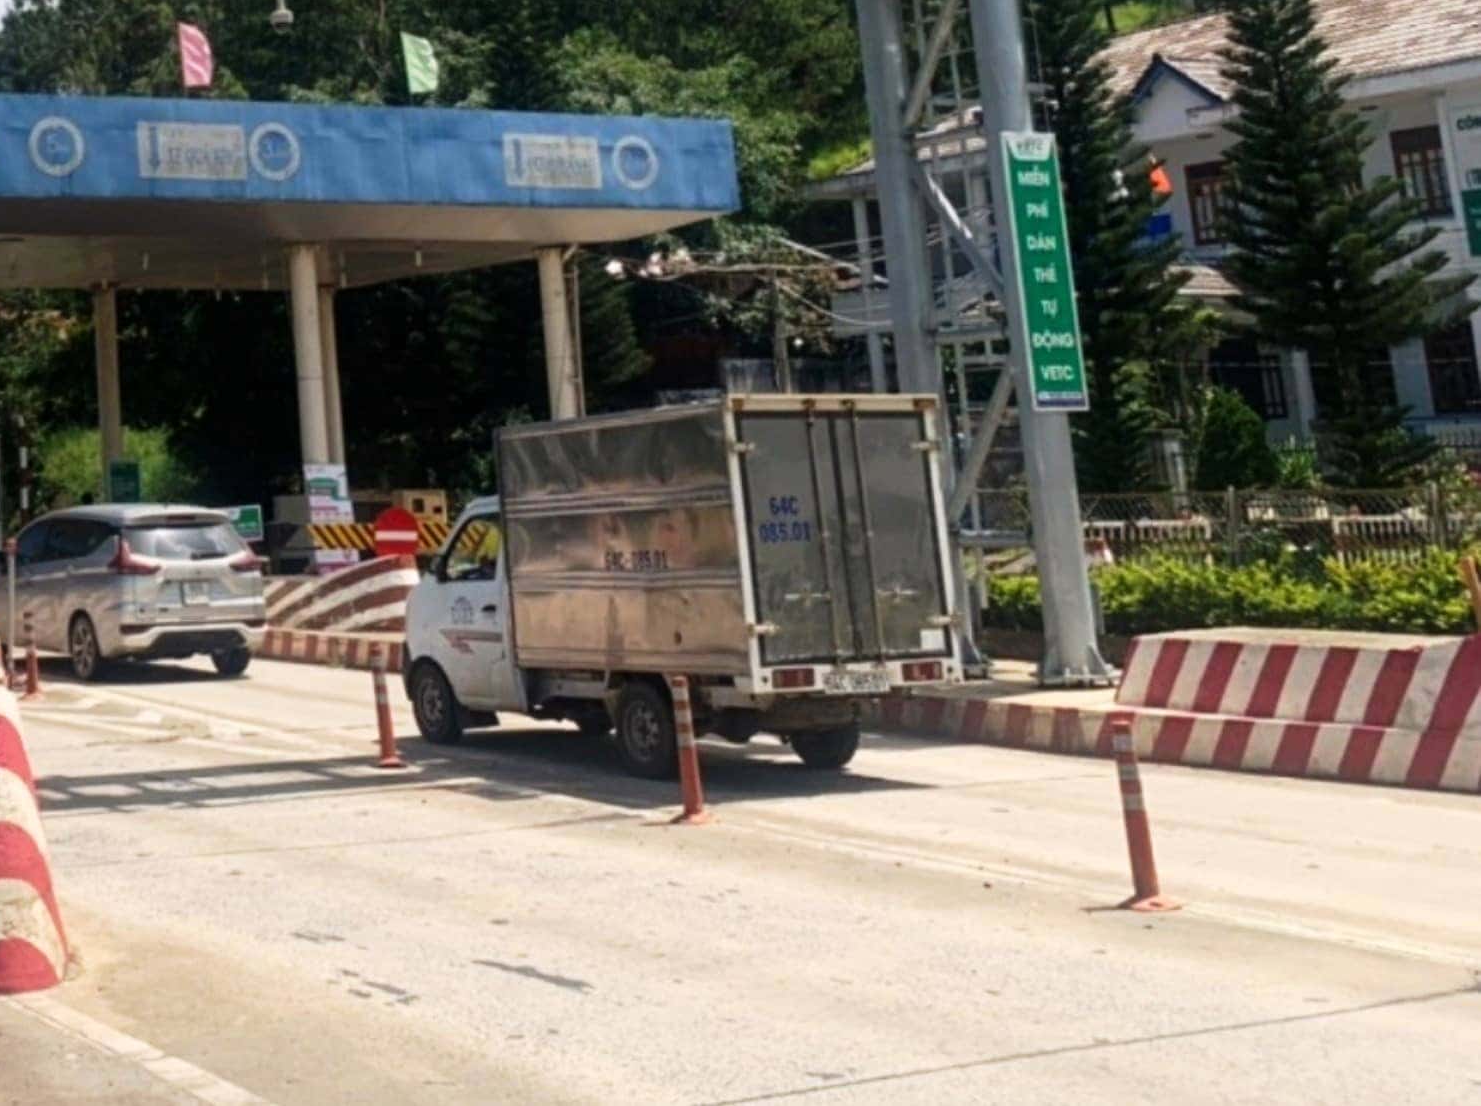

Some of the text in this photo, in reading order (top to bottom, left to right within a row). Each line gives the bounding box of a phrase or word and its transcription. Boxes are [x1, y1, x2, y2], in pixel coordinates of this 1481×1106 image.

[1031, 329, 1074, 352] ĐỘNG
[1040, 365, 1075, 381] VETC
[769, 496, 799, 514] 64C
